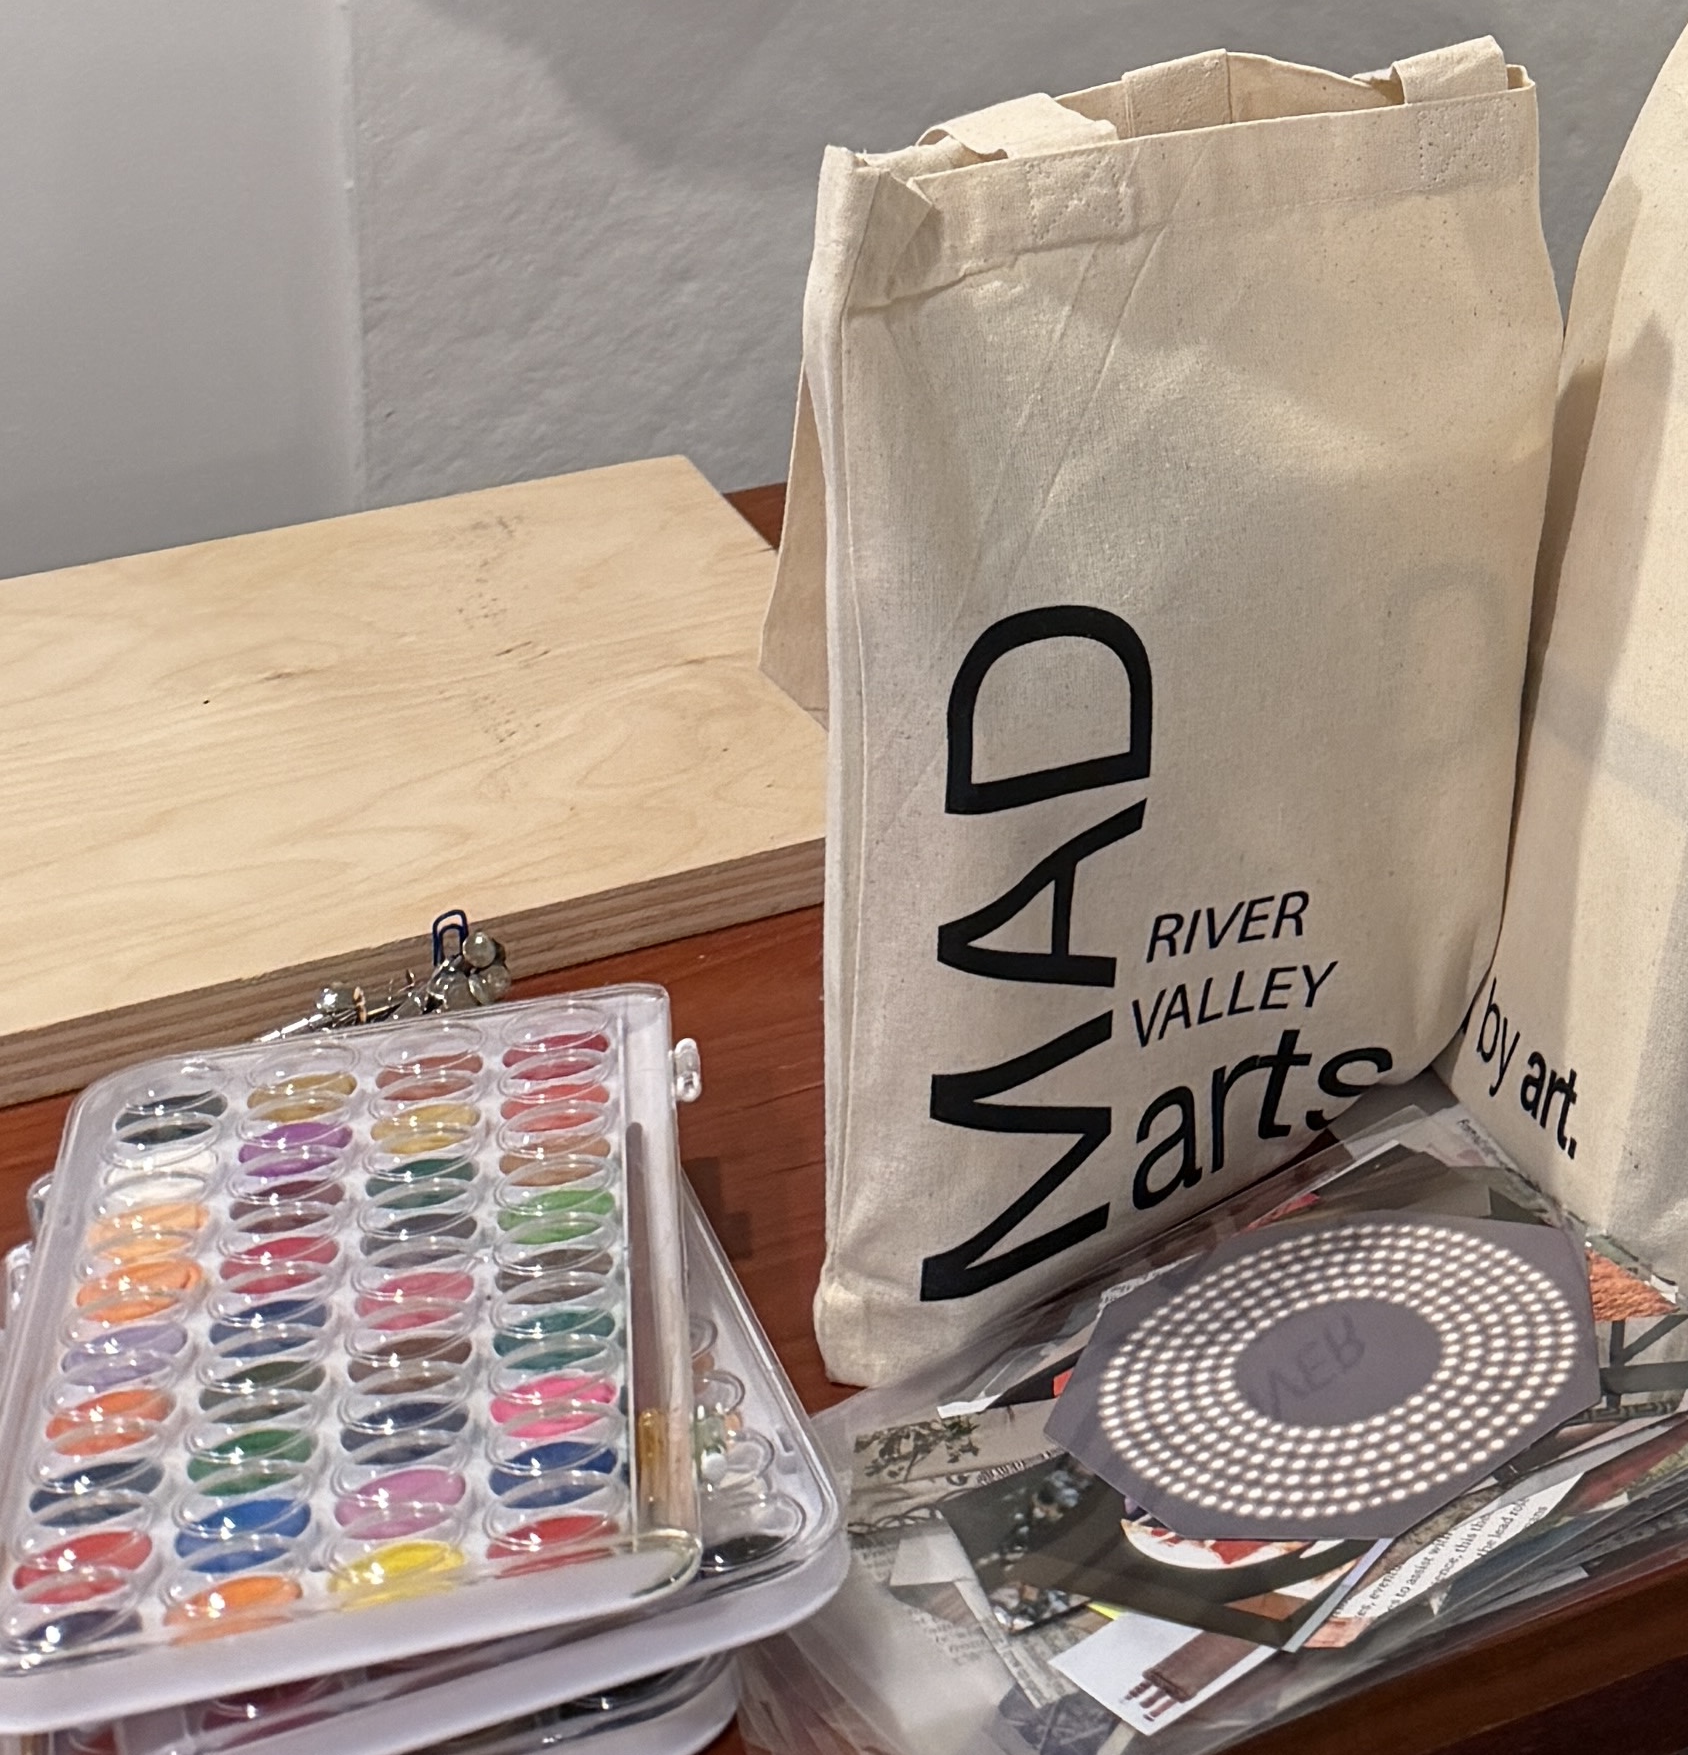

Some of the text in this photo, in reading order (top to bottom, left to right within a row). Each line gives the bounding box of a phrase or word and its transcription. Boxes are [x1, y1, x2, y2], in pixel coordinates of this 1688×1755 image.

[919, 604, 1155, 1304] MAD
[1131, 959, 1339, 1048] VALLEY
[1145, 890, 1310, 964] RIVER
[1131, 1028, 1394, 1211] arts
[1476, 977, 1521, 1098] by
[1519, 1049, 1579, 1160] art.
